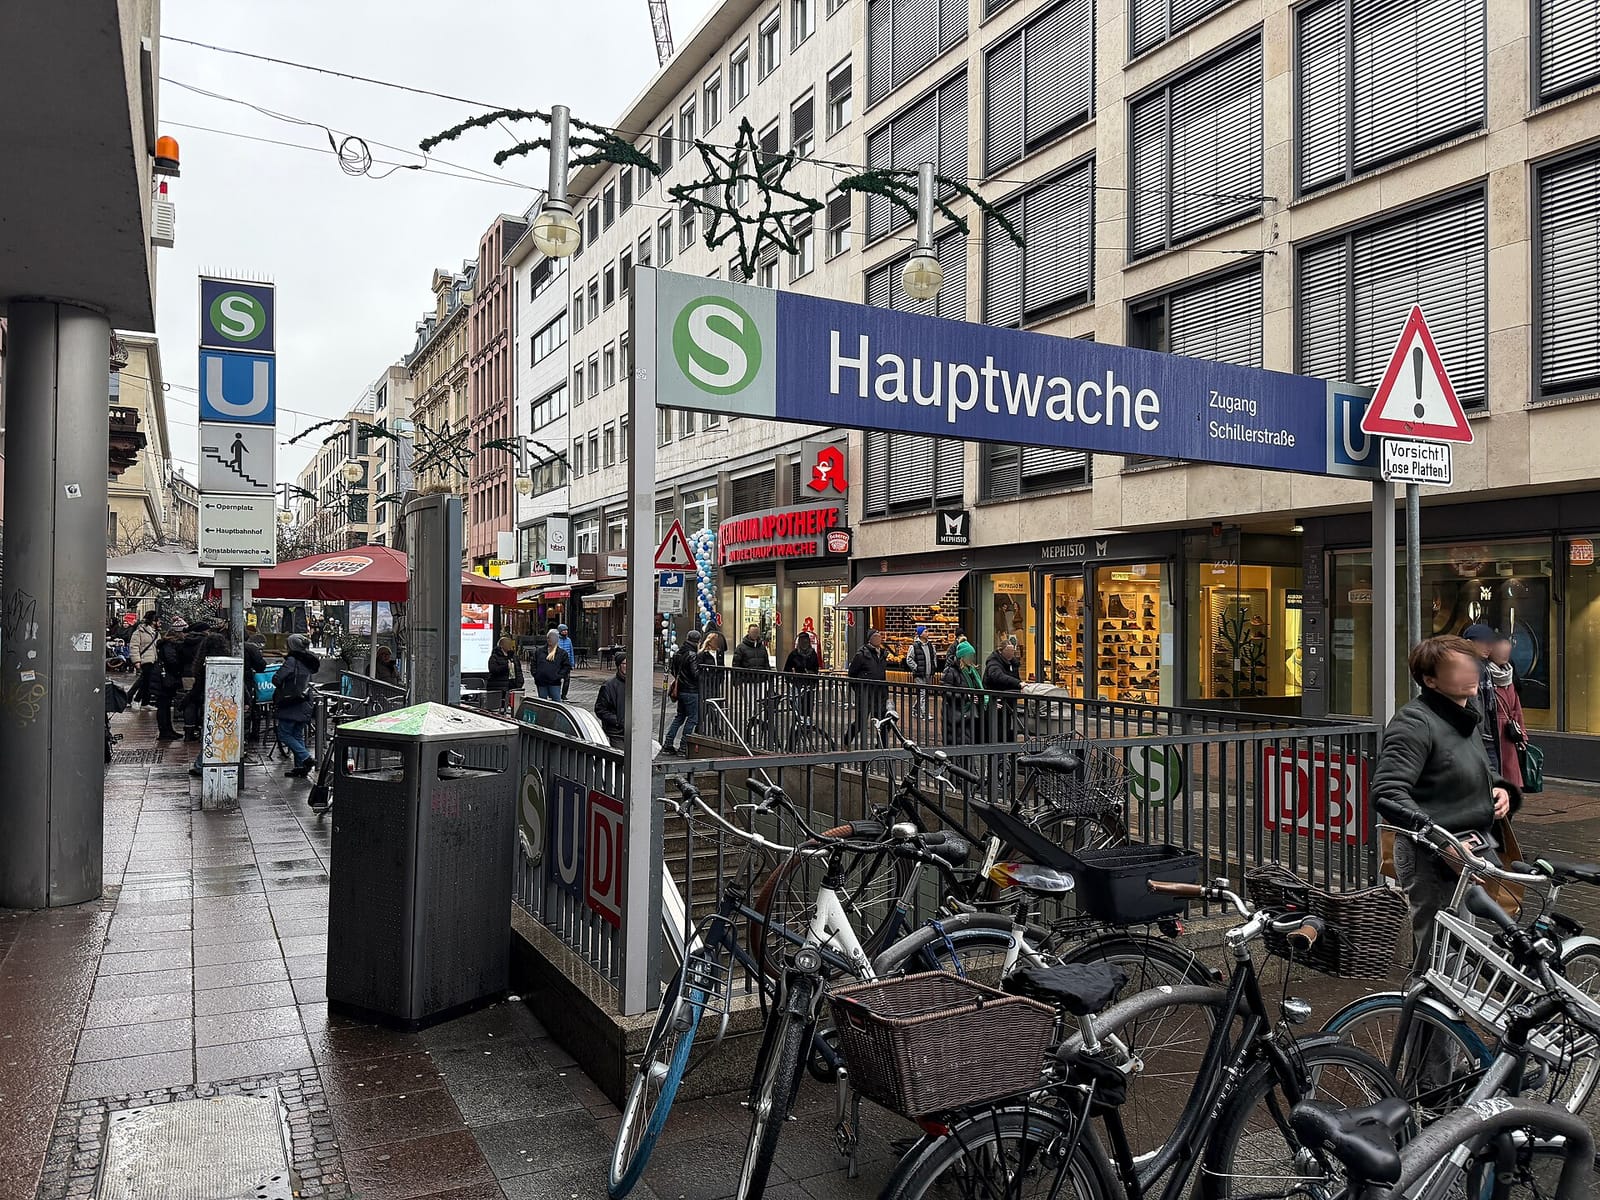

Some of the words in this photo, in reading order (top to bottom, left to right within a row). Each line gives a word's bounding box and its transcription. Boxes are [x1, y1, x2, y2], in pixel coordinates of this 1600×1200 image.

[220, 296, 255, 337] S
[687, 303, 748, 388] S
[206, 356, 269, 417] U
[830, 330, 1160, 431] Hauptwache
[1209, 390, 1257, 417] Zugang
[1209, 421, 1295, 448] Schillerstraße
[1391, 442, 1444, 462] Vorsicht!
[1387, 459, 1409, 474] Lose
[1412, 461, 1447, 478] Platten!
[216, 503, 254, 511] Opernplatz
[761, 508, 839, 539] APOTHEKE
[203, 547, 260, 555] Konstablerwache
[751, 542, 817, 559] HAUPTWACHE
[1041, 543, 1086, 559] MEPHISTO
